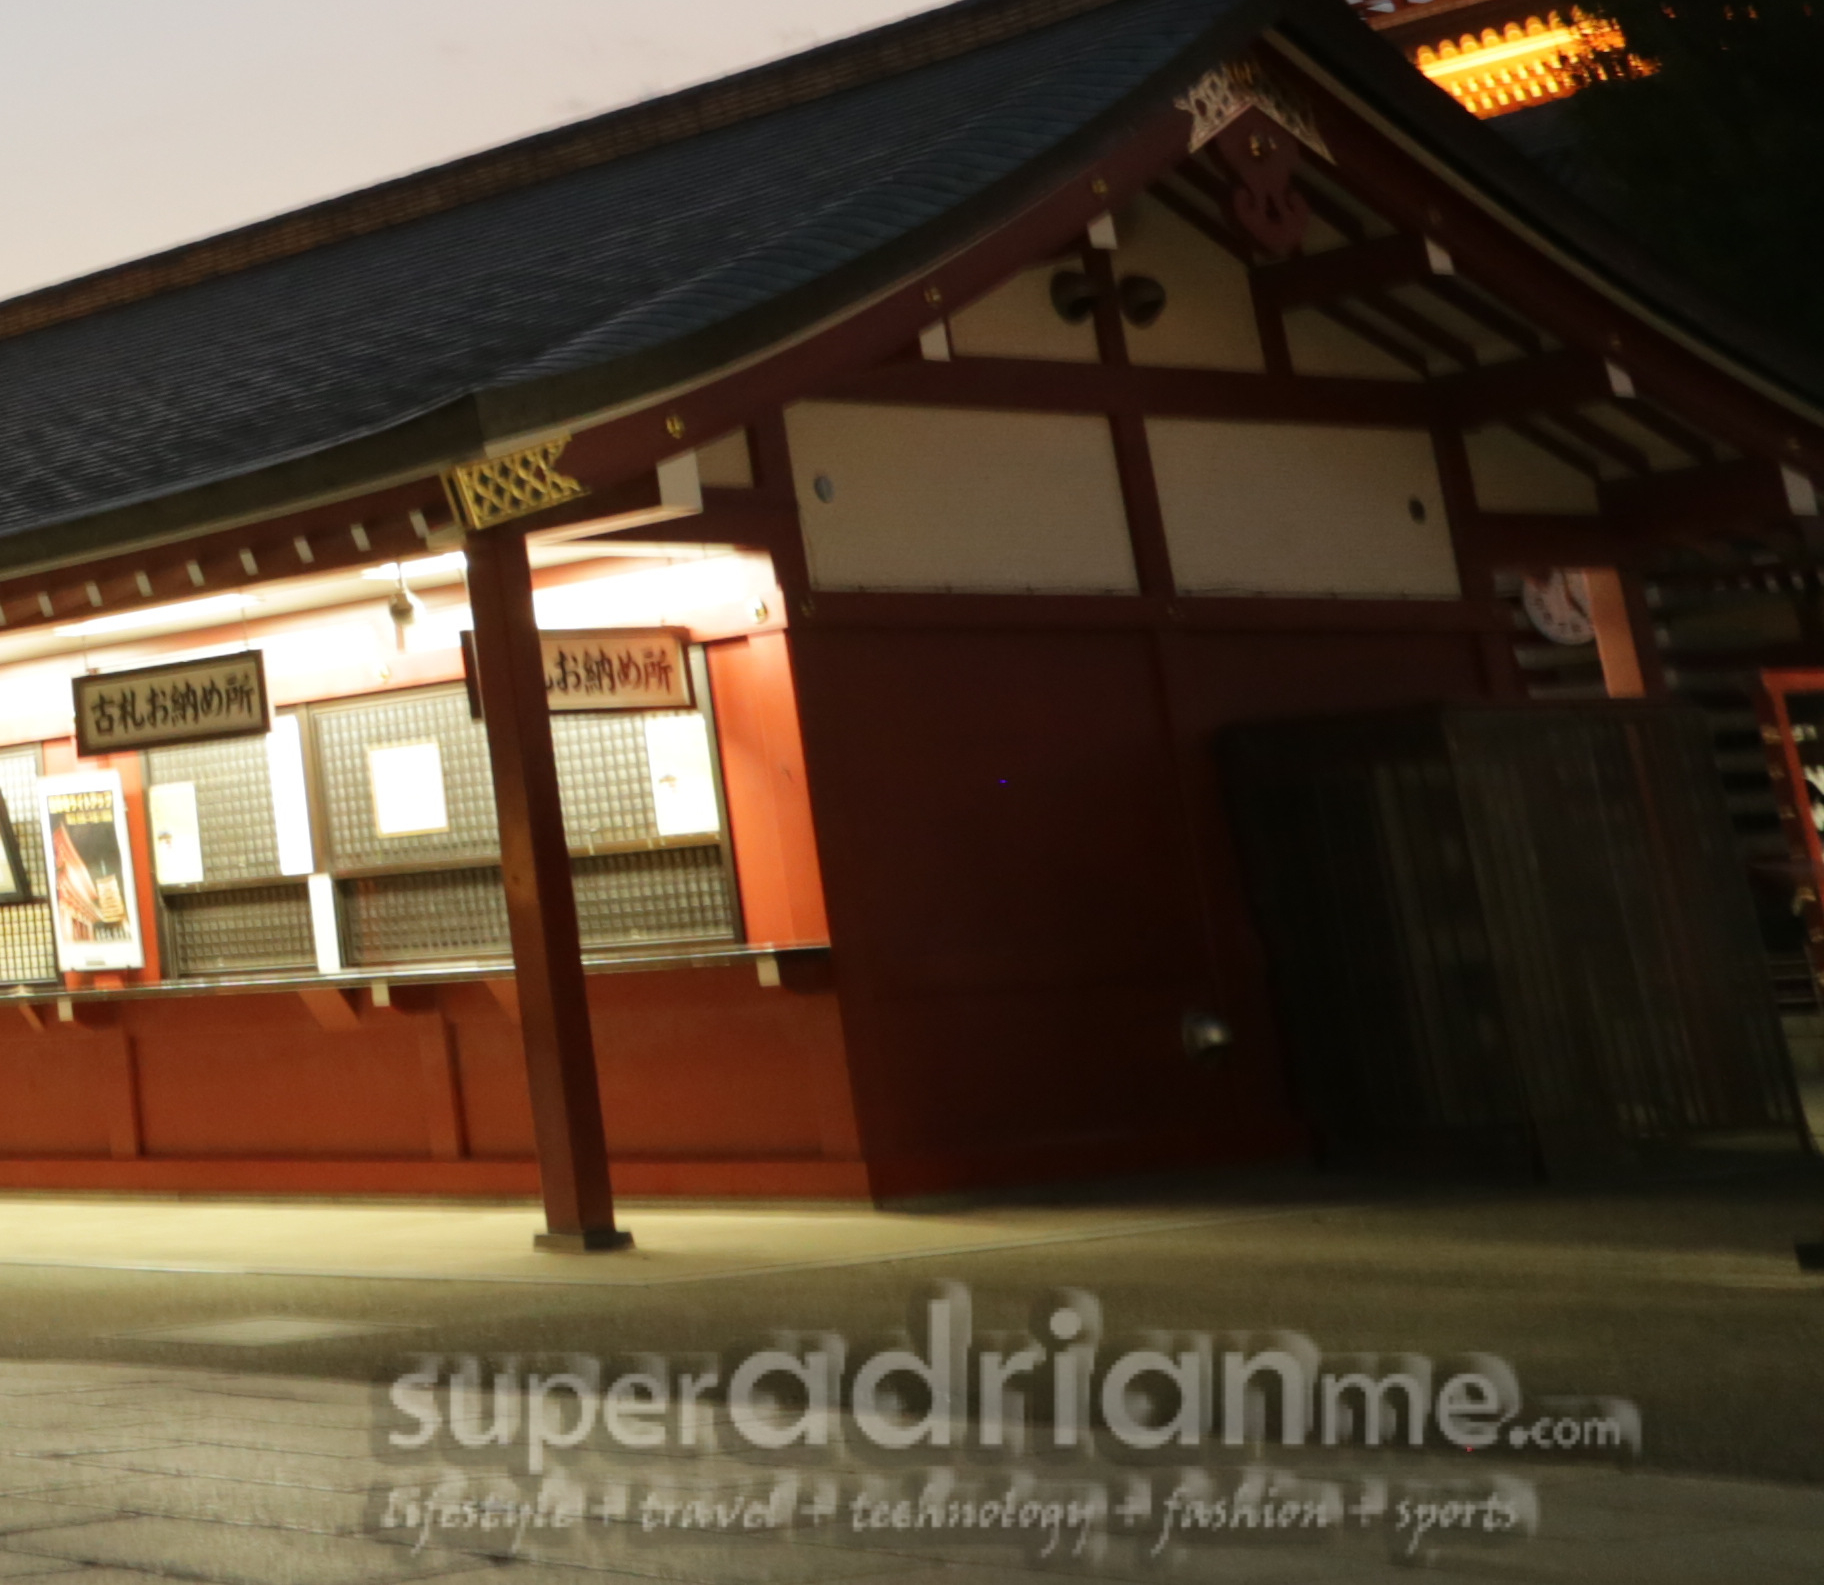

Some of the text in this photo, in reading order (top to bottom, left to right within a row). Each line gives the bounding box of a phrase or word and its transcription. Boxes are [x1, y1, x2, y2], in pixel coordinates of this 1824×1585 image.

[545, 647, 673, 696] お納め所
[90, 672, 255, 737] 古札お納め所
